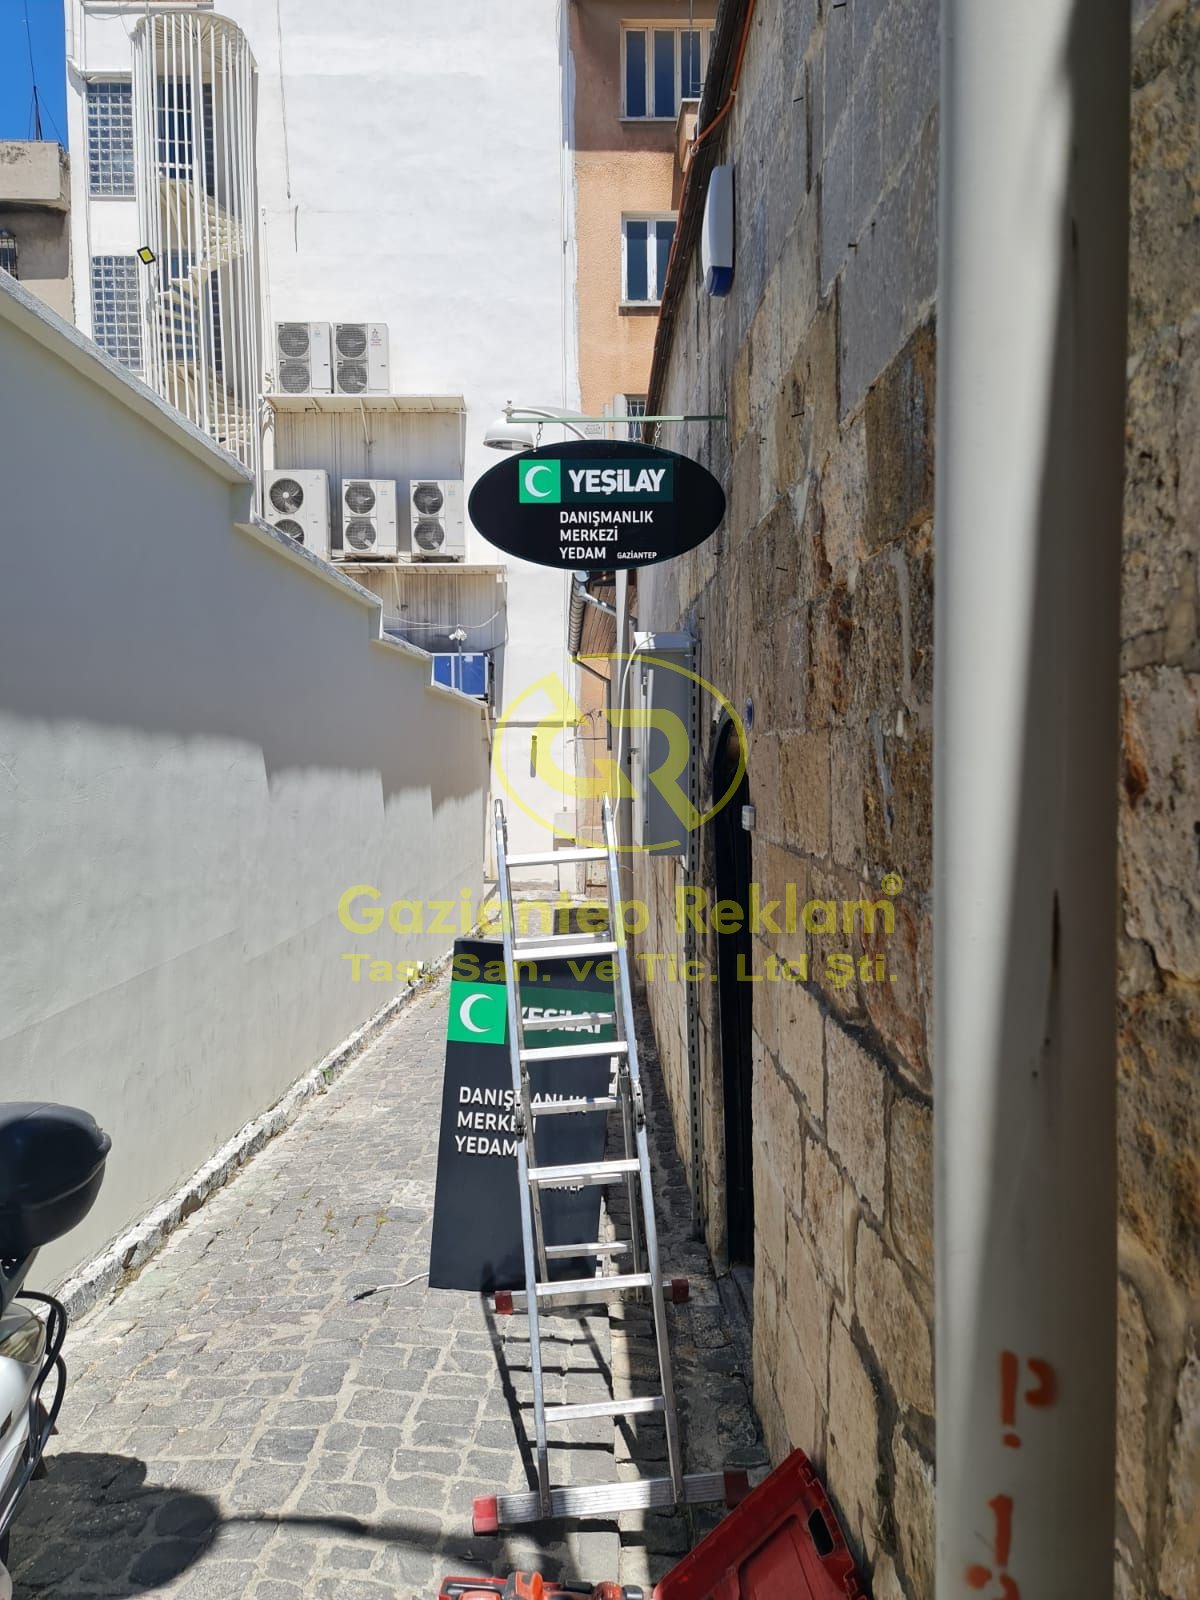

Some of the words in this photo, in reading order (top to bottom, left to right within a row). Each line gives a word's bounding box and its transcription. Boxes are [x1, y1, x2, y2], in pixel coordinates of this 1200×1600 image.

[559, 510, 654, 527] DANIŞMANLIK
[559, 526, 618, 542] MERKEZİ
[559, 546, 606, 560] YEDAM
[454, 1135, 519, 1157] YEDAM
